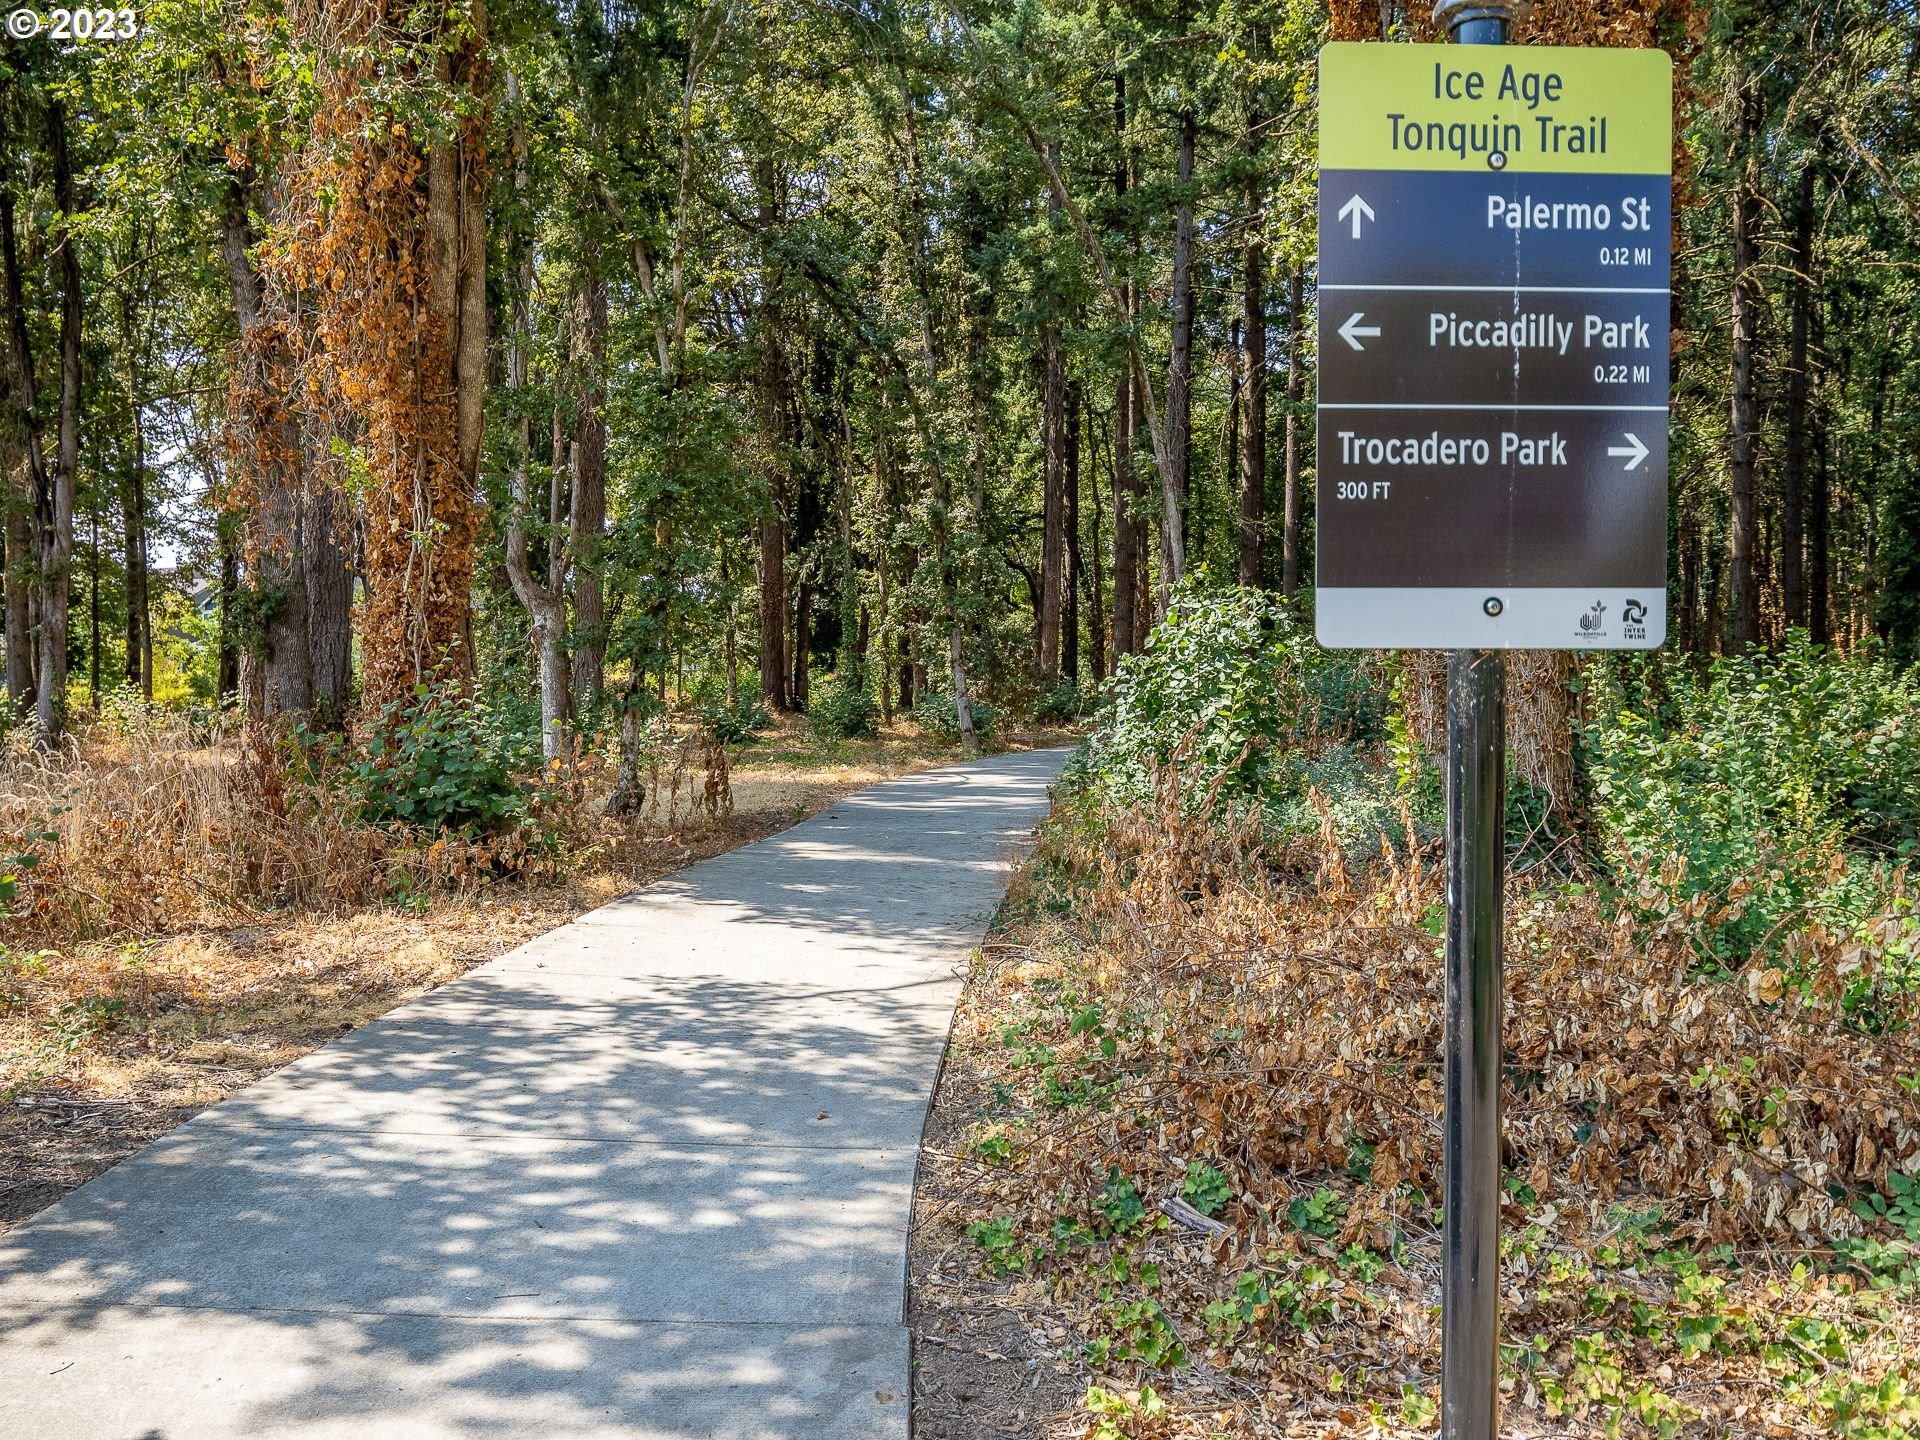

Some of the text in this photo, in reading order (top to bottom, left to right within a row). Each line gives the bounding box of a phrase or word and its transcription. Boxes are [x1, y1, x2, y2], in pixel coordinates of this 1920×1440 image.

[1434, 63, 1563, 110] Ice Age
[1386, 113, 1607, 160] Tonquin Trail
[1487, 195, 1651, 231] Palermo St
[1600, 247, 1651, 265] 0.12 MI
[1429, 313, 1650, 356] Piccadilly Park
[1594, 365, 1650, 384] 0.22 MI
[1337, 431, 1568, 465] Trocadero Park
[1337, 481, 1391, 500] 300 FT
